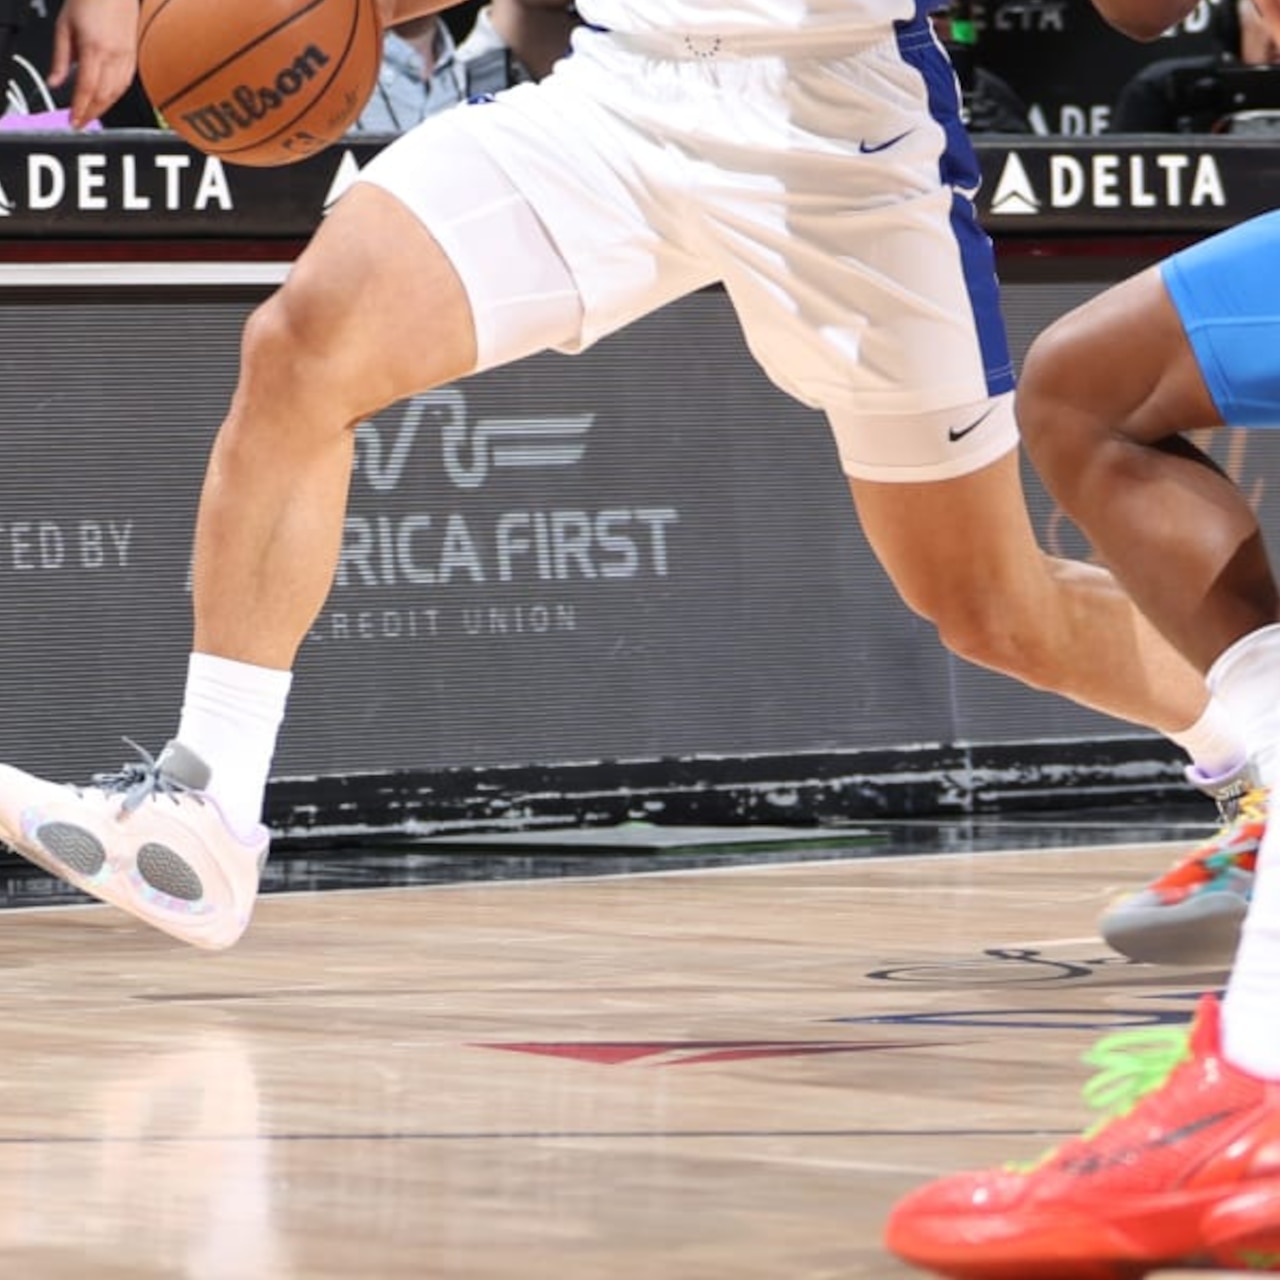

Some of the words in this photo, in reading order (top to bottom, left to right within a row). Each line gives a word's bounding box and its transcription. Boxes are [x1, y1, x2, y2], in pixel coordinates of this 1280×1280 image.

[181, 43, 329, 143] Wilson
[27, 154, 233, 211] DELTA
[1050, 154, 1225, 207] DELTA
[80, 520, 133, 568] BY
[495, 508, 678, 581] FIRST
[462, 604, 576, 635] UNION
